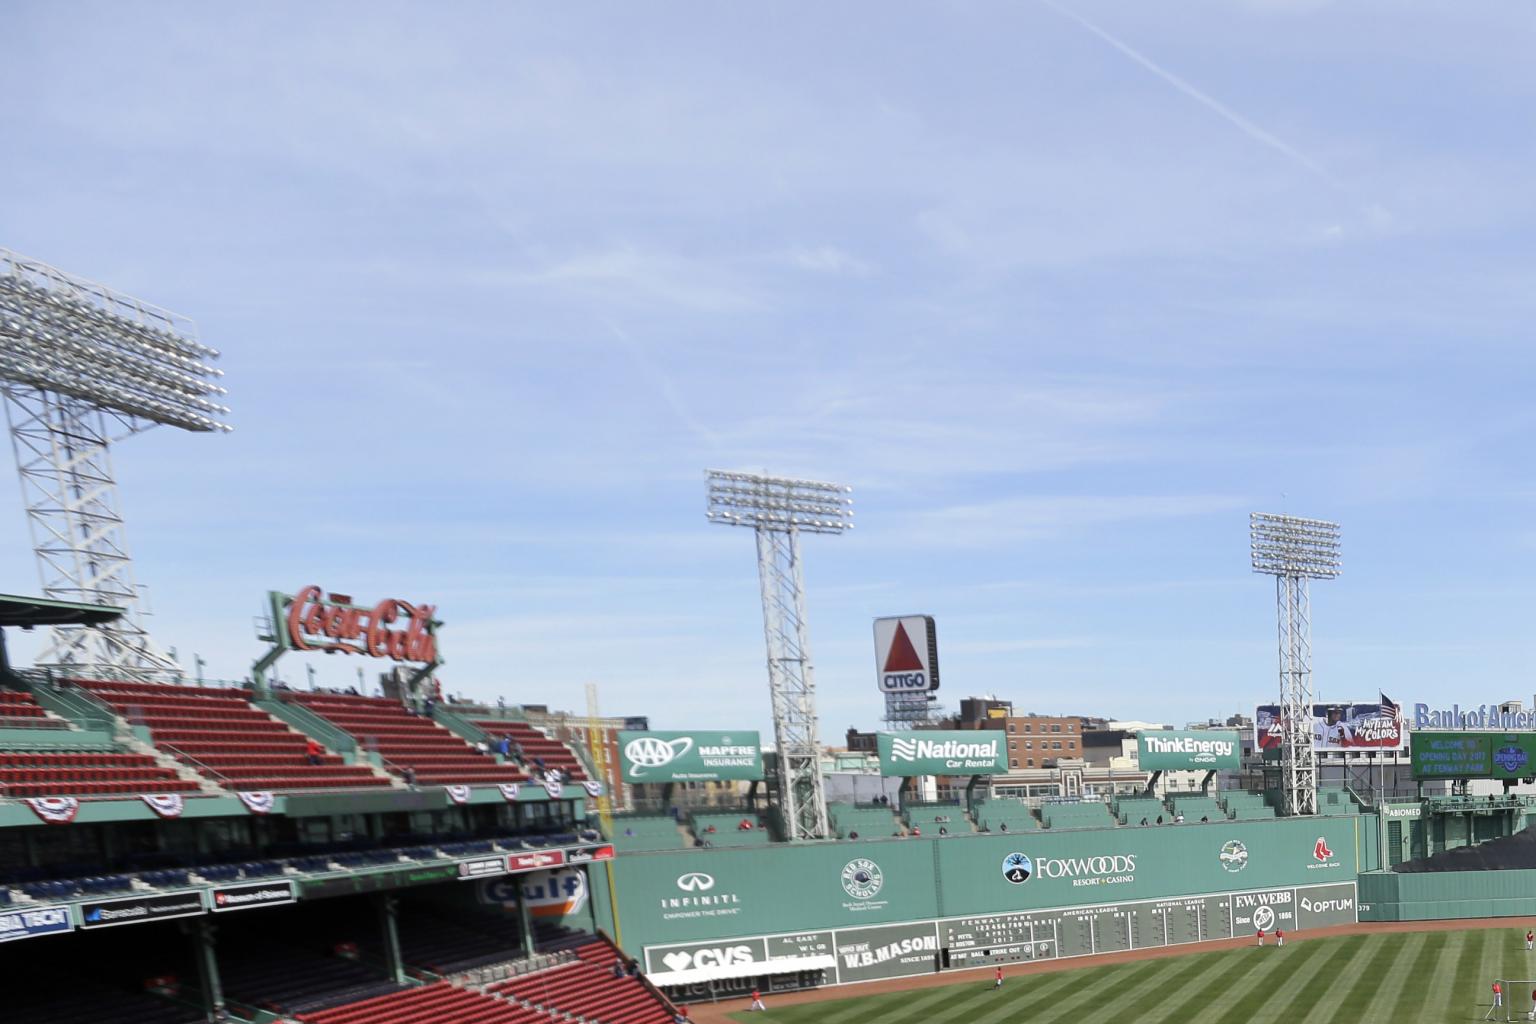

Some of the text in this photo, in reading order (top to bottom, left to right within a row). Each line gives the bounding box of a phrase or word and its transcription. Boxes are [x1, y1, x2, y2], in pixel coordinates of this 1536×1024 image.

[288, 584, 438, 665] Coca-Cola
[884, 673, 925, 688] CITGO
[1415, 703, 1465, 729] Bank
[1466, 704, 1486, 729] of
[629, 739, 671, 766] AAA
[698, 746, 755, 756] MAPFRE
[917, 740, 998, 758] National
[1144, 737, 1234, 756] ThinkEnergy
[703, 758, 754, 767] INSURANCE
[946, 759, 995, 768] Car Rental
[1390, 809, 1421, 817] ABIOMED
[843, 860, 875, 879] RED SOX
[1035, 854, 1136, 879] FOXWOODS
[486, 875, 579, 903] Gulf
[845, 874, 881, 897] SCHOLARS
[1073, 875, 1134, 887] RESORT CASINO
[1258, 892, 1292, 905] WEBB
[1313, 898, 1353, 913] OPTUM
[962, 918, 1000, 926] FENWAY
[1236, 916, 1250, 925] Since
[693, 945, 753, 968] CVS
